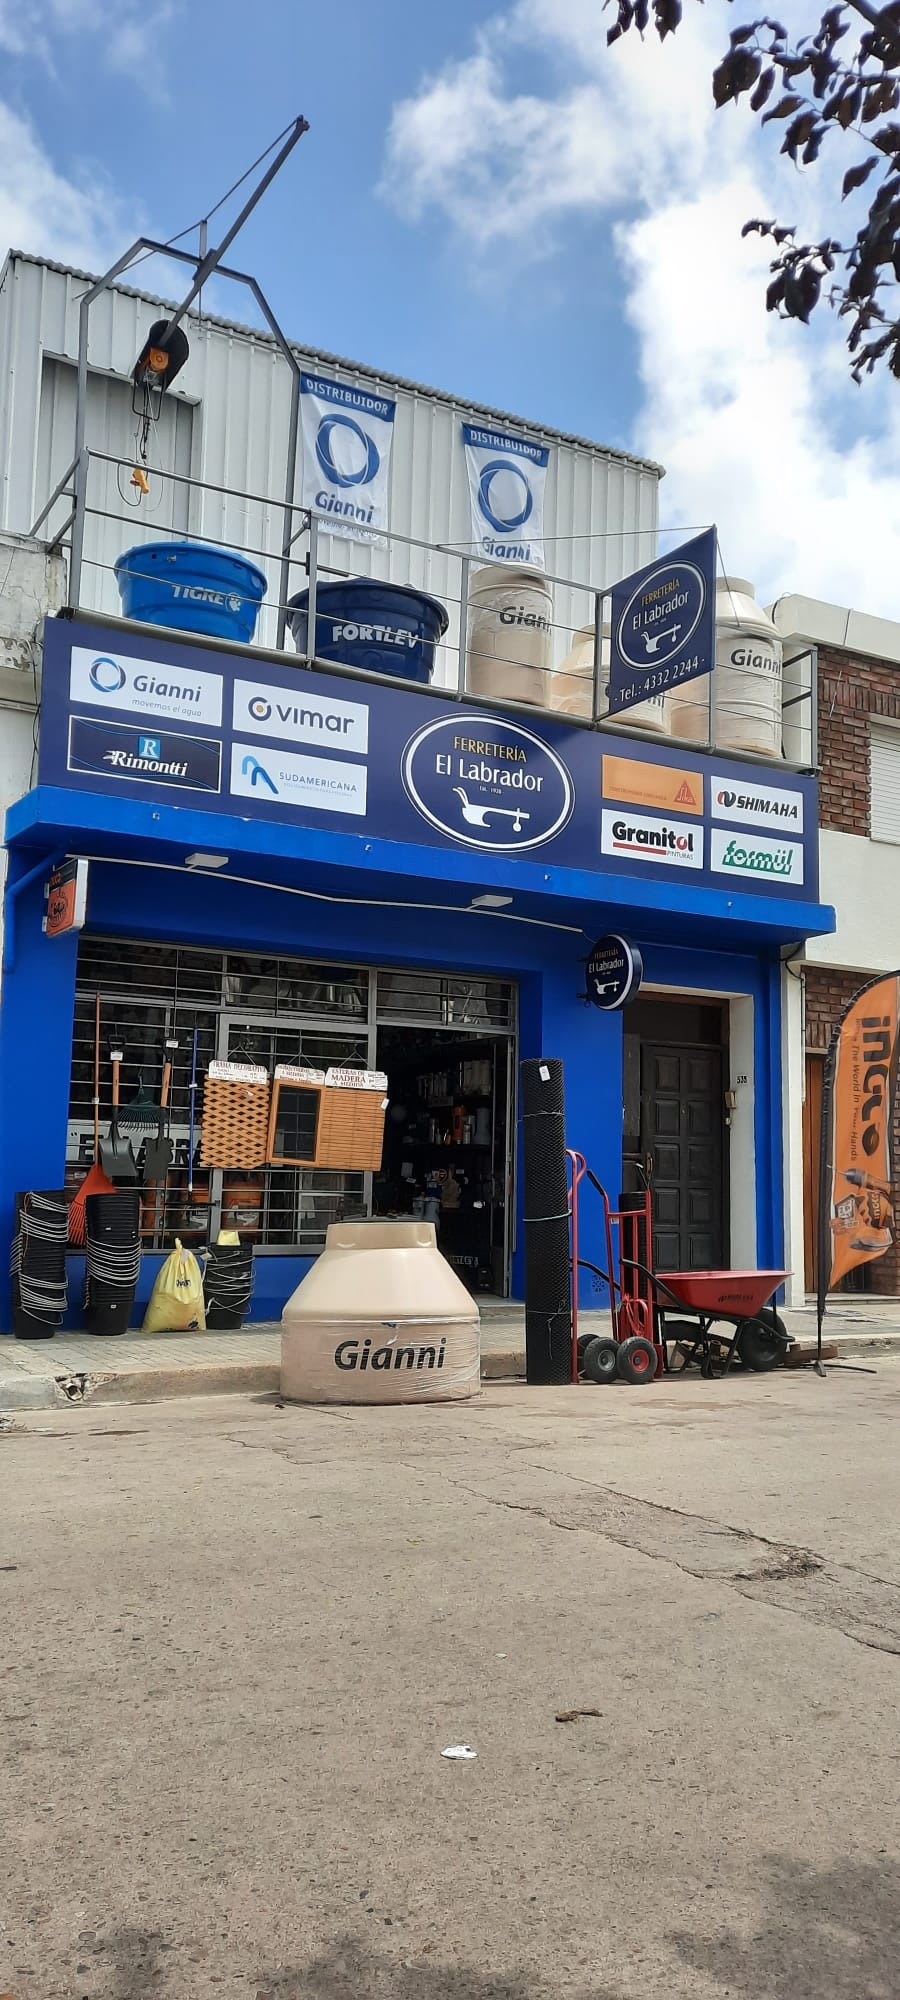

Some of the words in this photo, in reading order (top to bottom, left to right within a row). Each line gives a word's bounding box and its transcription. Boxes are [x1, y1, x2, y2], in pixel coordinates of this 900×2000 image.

[306, 379, 389, 416] DISTRIBUIDOR
[470, 430, 543, 460] DISTRIBUIDOR
[315, 490, 375, 524] Gianni
[482, 536, 531, 562] Gianni
[171, 584, 224, 605] TIGRE
[641, 578, 681, 607] FERRETERÍA
[632, 613, 641, 631] El
[644, 590, 689, 626] Labrador
[331, 625, 420, 648] FORTLEV
[644, 669, 670, 692] 4332
[672, 655, 699, 680] 2244
[133, 675, 202, 703] Gianni
[131, 699, 171, 712] movemos
[172, 705, 181, 713] el
[181, 707, 202, 717] agua
[276, 704, 355, 734] vimar
[453, 736, 528, 763] FERRETERÍA
[108, 750, 188, 777] Rimontti
[436, 754, 451, 776] El
[459, 758, 544, 792] Labrador
[279, 771, 358, 793] SUDAMERICANA
[736, 795, 799, 819] SHIMAHA
[612, 821, 694, 852] Granitol
[666, 850, 694, 860] PINTURAS
[588, 963, 595, 973] El
[596, 958, 624, 972] Labrador
[331, 1074, 366, 1083] MADERA
[852, 1064, 861, 1091] World
[850, 1131, 859, 1161] Hands
[334, 1337, 447, 1371] Gianni
